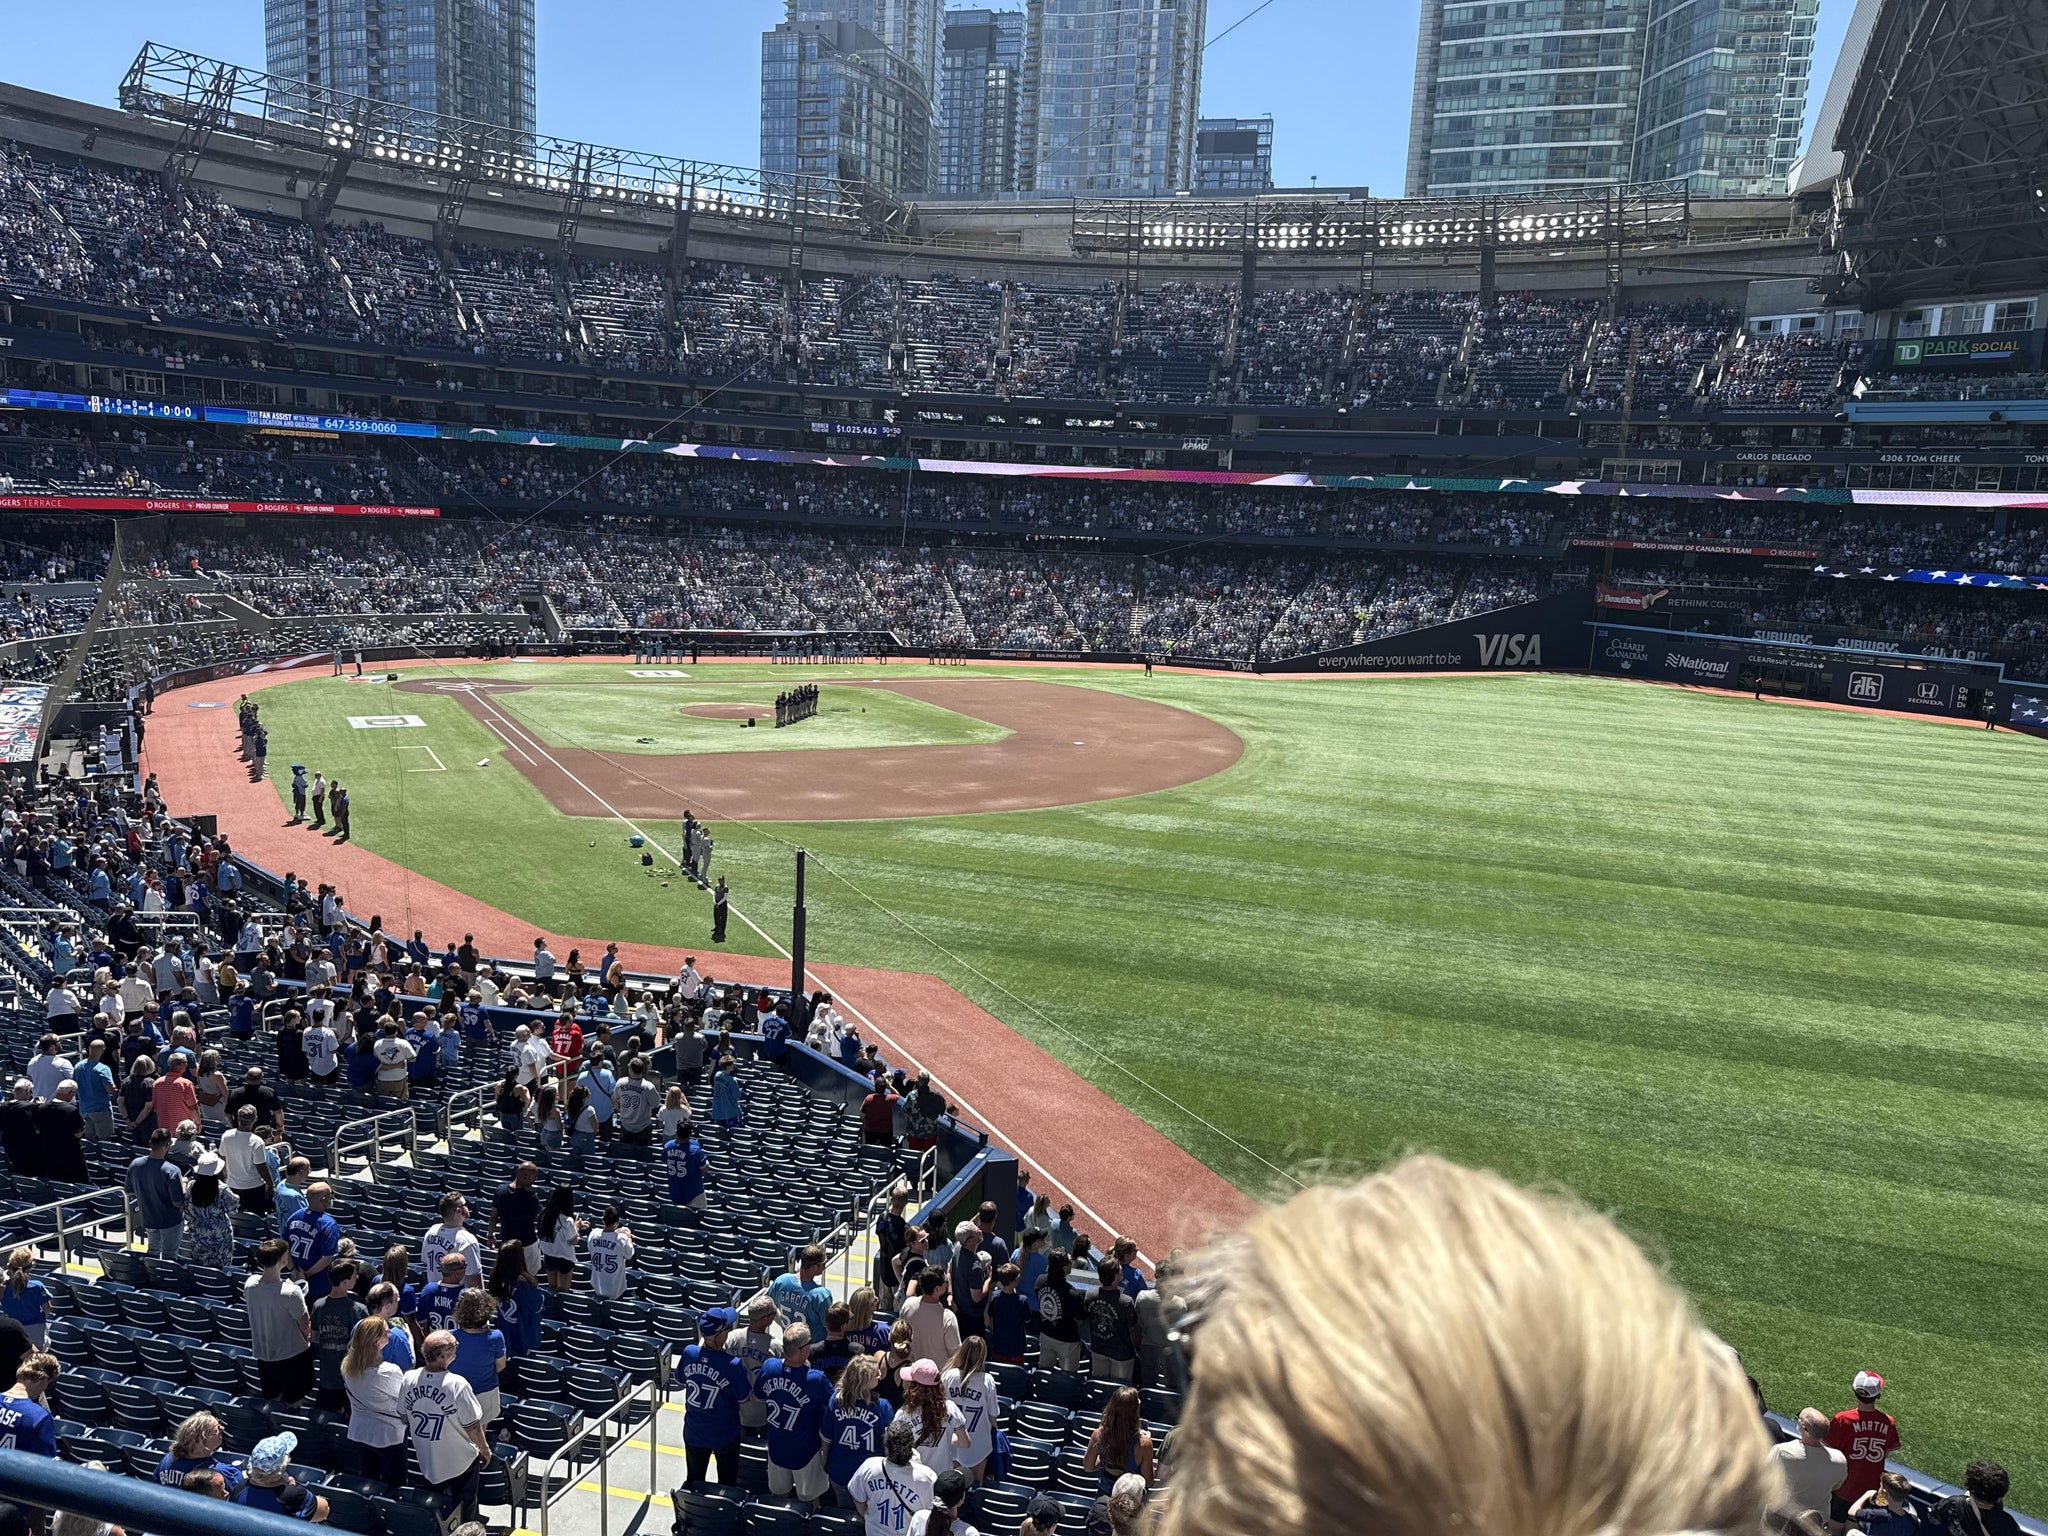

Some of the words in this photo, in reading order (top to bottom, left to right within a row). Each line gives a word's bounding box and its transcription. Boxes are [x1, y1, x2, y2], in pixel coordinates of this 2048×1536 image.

[1898, 344, 1920, 360] TD
[1924, 340, 1970, 354] PARK
[1971, 340, 2019, 352] SOCIAL
[164, 406, 170, 416] 0
[174, 406, 180, 416] 0
[185, 407, 192, 417] 0
[272, 412, 292, 421] ASSIST
[260, 418, 282, 426] LOCATION
[325, 418, 397, 433] 647-559-0060
[1182, 442, 1208, 450] KPMG
[1736, 453, 1768, 461] CARLOS
[1772, 453, 1812, 462] DELGADO
[1880, 454, 1903, 463] 4306
[1905, 454, 1928, 463] TOM
[1930, 454, 1962, 463] CHEEK
[0, 498, 21, 508] GERS
[22, 499, 62, 508] TERRACE
[195, 502, 211, 510] PROUD
[264, 504, 288, 512] ROGERS
[368, 506, 390, 514] ROGERS
[420, 508, 434, 516] OWNER
[1632, 542, 1656, 550] PROUD
[1696, 545, 1730, 554] CANADA'S
[1732, 546, 1752, 554] TEAM
[1668, 598, 1708, 608] RETHINK
[1612, 638, 1647, 652] CLEARLY
[1753, 630, 1813, 645] SUBWAY
[1472, 634, 1542, 666] VISA
[1836, 638, 1899, 653] SUBWAY
[1318, 654, 1384, 668] everywhere
[1384, 656, 1406, 668] you
[1408, 654, 1434, 665] want
[1434, 654, 1446, 664] to
[1448, 652, 1462, 664] be
[1606, 646, 1648, 662] CANADIAN
[1232, 662, 1253, 672] VISA
[1748, 655, 1788, 666] CLEAResult
[1790, 660, 1818, 669] Canada
[1706, 671, 1726, 679] Rental
[1908, 697, 1944, 706] HONDA
[585, 1002, 599, 1015] 29
[463, 1012, 480, 1026] 39
[766, 1030, 778, 1040] 27
[308, 1042, 324, 1058] 31
[554, 1040, 572, 1053] 77
[621, 1094, 642, 1110] 39
[666, 1148, 686, 1160] MARTIN
[668, 1159, 688, 1178] 55
[288, 1234, 314, 1260] 27
[592, 1238, 616, 1251] SNIDER
[428, 1250, 444, 1272] 19
[591, 1252, 619, 1274] 45
[434, 1295, 453, 1309] KIRK
[428, 1311, 460, 1330] 30
[846, 1334, 878, 1347] YOUNG
[684, 1364, 721, 1381] GUERRERO
[716, 1376, 730, 1390] JR
[686, 1380, 720, 1410] 27
[762, 1377, 802, 1400] GUERRERO
[796, 1395, 811, 1408] JR
[950, 1386, 982, 1402] BAGER
[406, 1386, 448, 1412] GUERRERO
[440, 1400, 458, 1416] JR
[766, 1399, 801, 1432] 27
[955, 1405, 984, 1434] 7
[411, 1410, 446, 1442] 27
[1852, 1420, 1890, 1435] MARTIN
[838, 1425, 875, 1453] 41
[1850, 1437, 1886, 1463] 55
[868, 1478, 920, 1504] BICHETTE
[877, 1498, 905, 1531] 11
